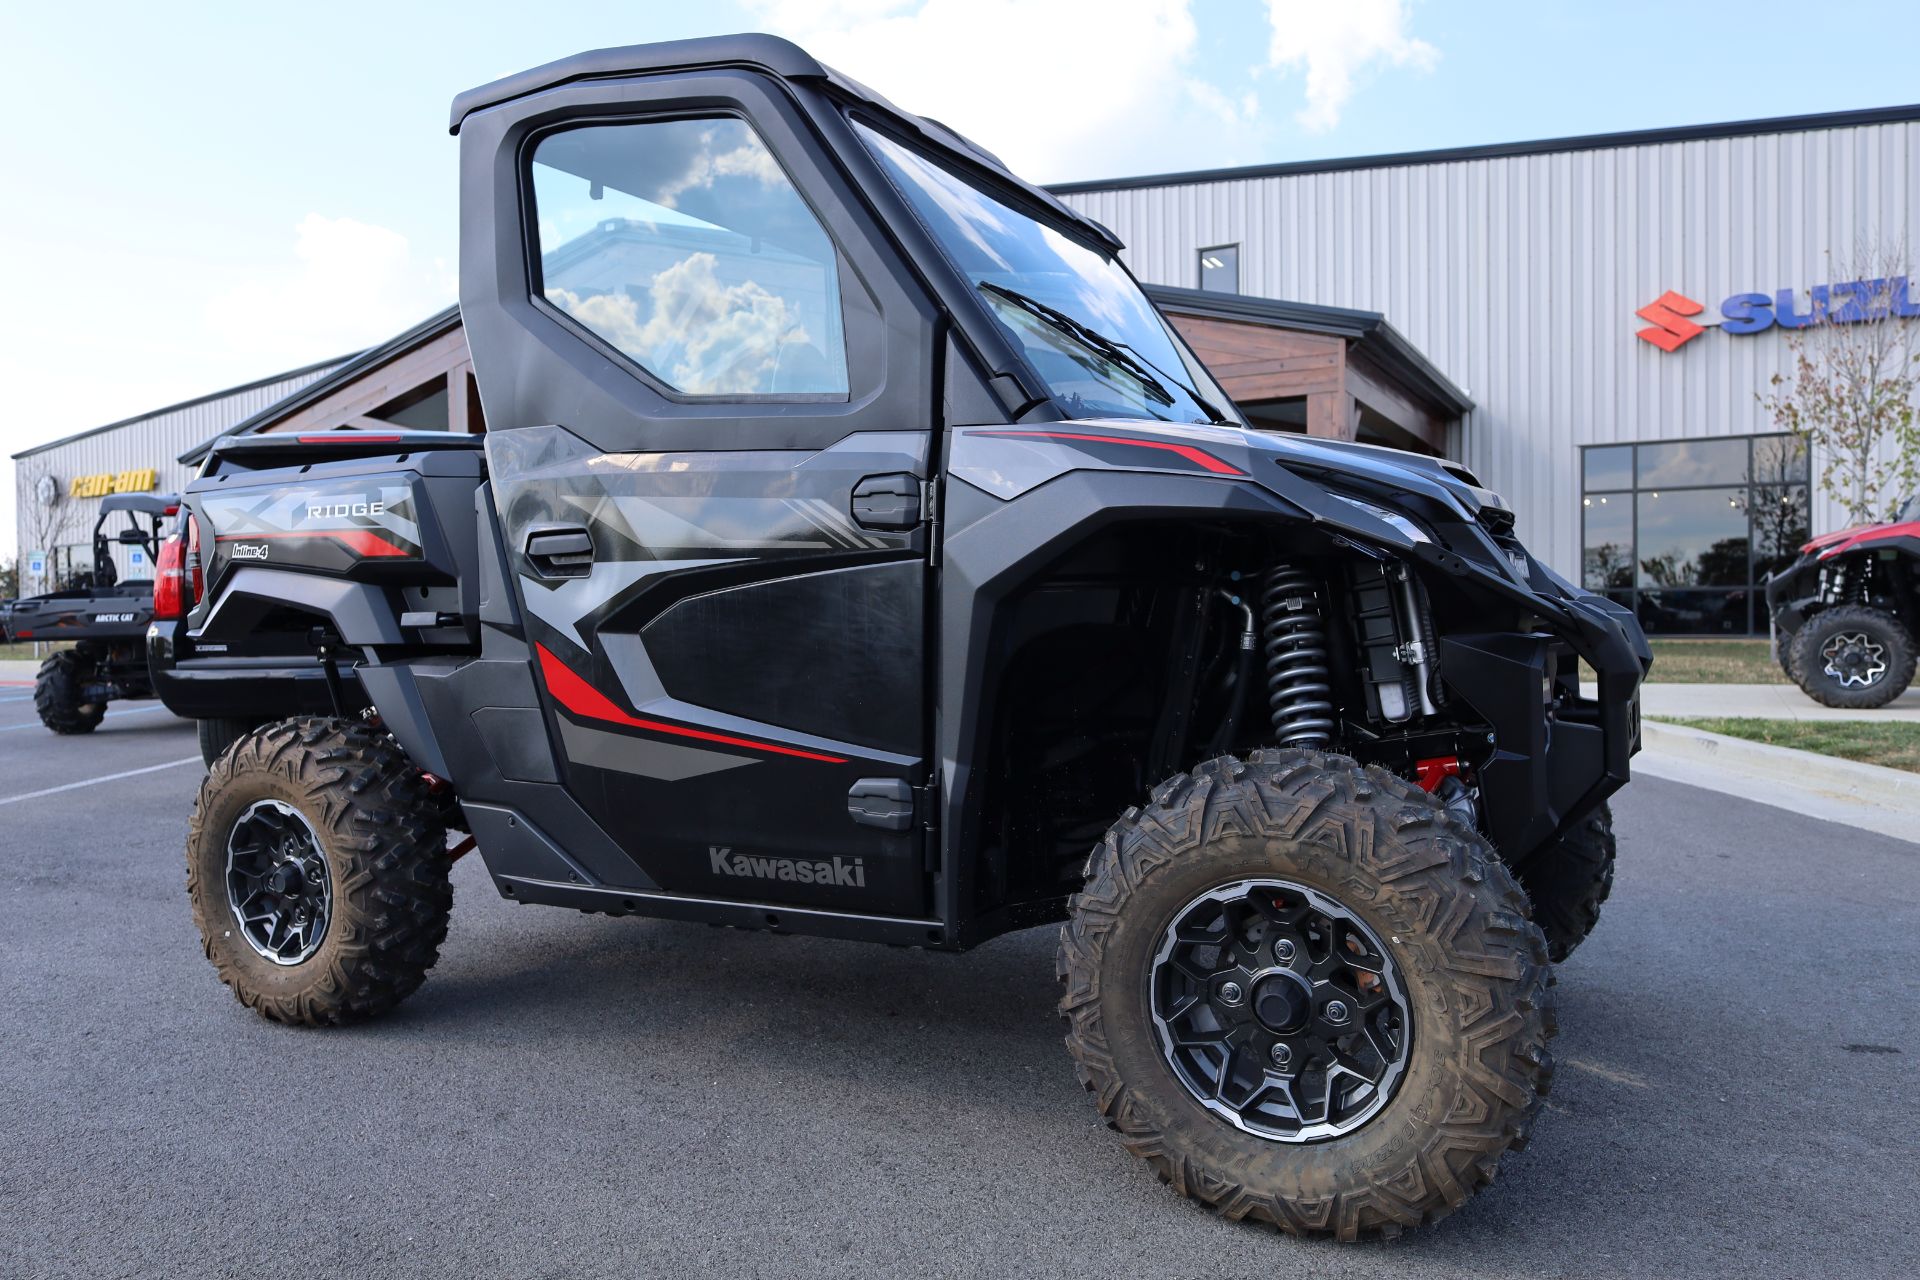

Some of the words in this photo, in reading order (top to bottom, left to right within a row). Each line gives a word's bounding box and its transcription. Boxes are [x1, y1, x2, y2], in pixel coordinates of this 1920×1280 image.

[307, 501, 385, 520] RIDGE
[231, 543, 269, 560] Inline-4
[95, 613, 120, 622] ARCTIC
[120, 612, 134, 622] CAT
[709, 847, 865, 887] Kawasaki
